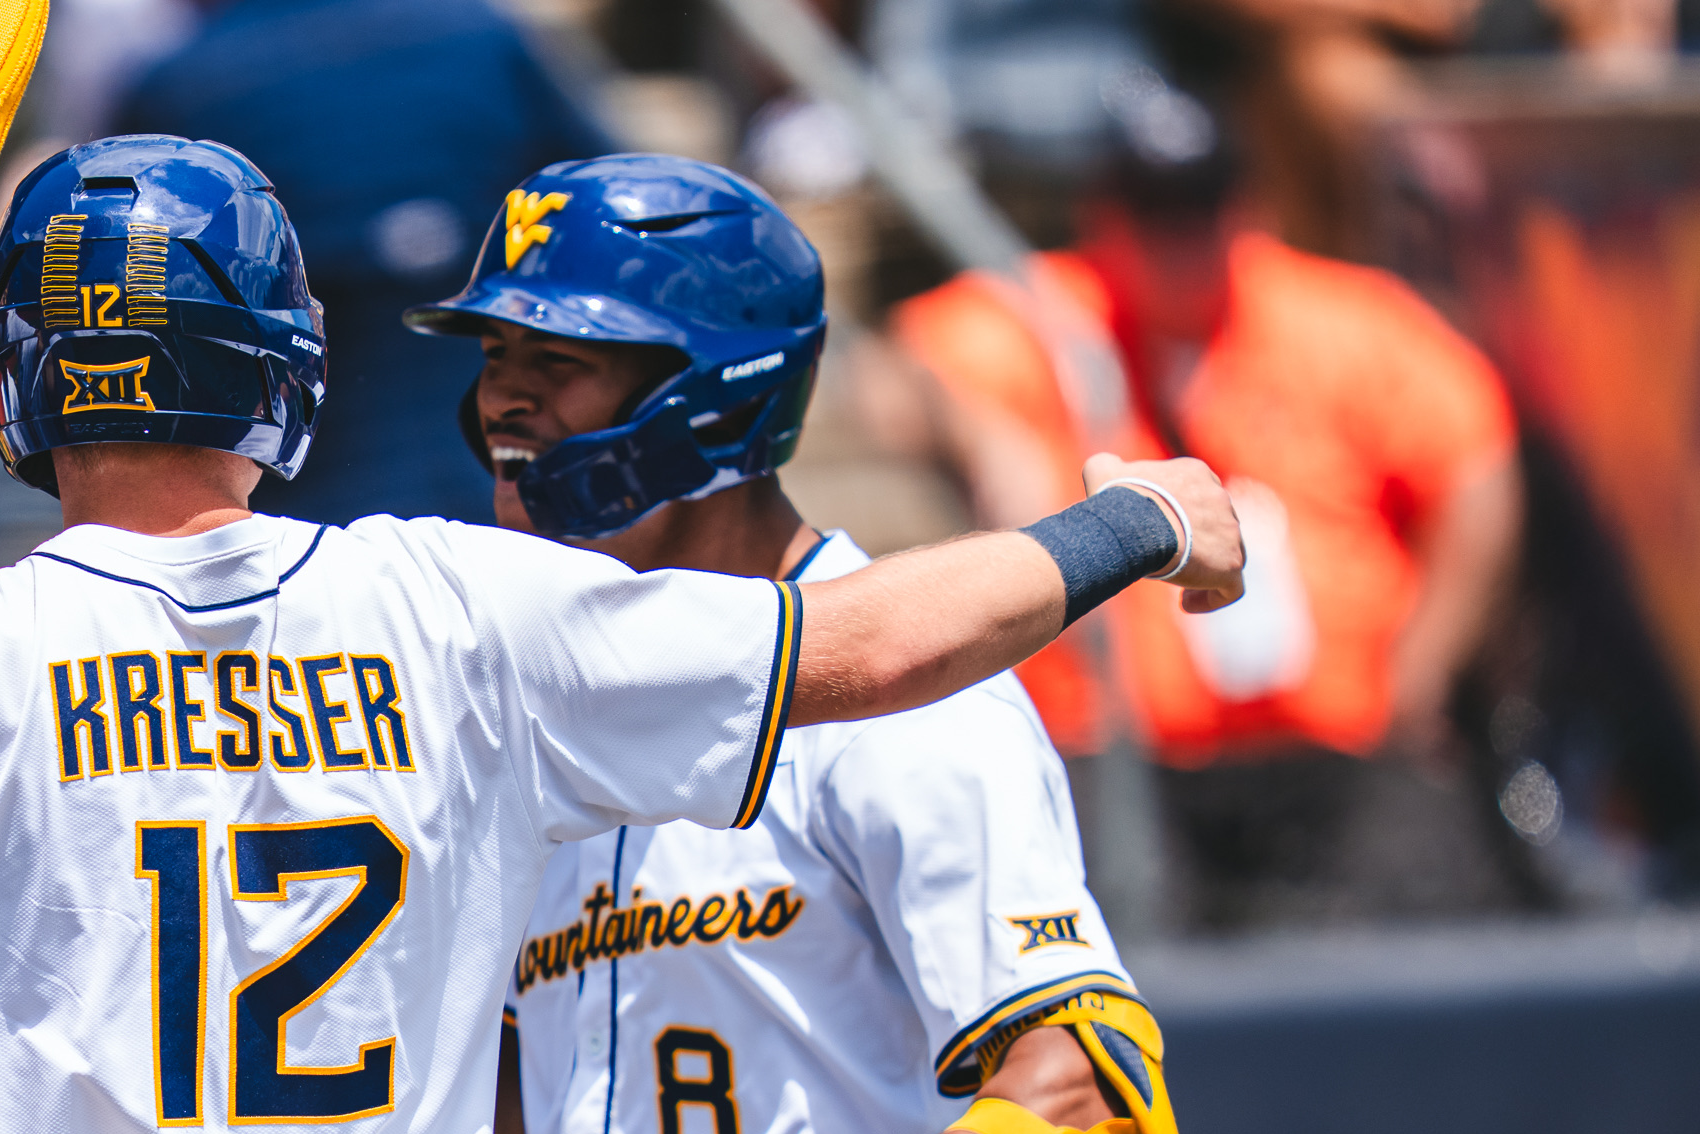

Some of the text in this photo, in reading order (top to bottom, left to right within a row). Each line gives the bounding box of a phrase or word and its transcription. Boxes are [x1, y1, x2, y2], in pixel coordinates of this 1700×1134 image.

[80, 284, 123, 327] 12
[291, 334, 322, 357] EASTON
[722, 351, 785, 382] EASTON
[48, 648, 417, 783] KRESSER
[513, 876, 805, 997] ountaineers
[1004, 909, 1094, 957] XII
[135, 814, 411, 1127] 12
